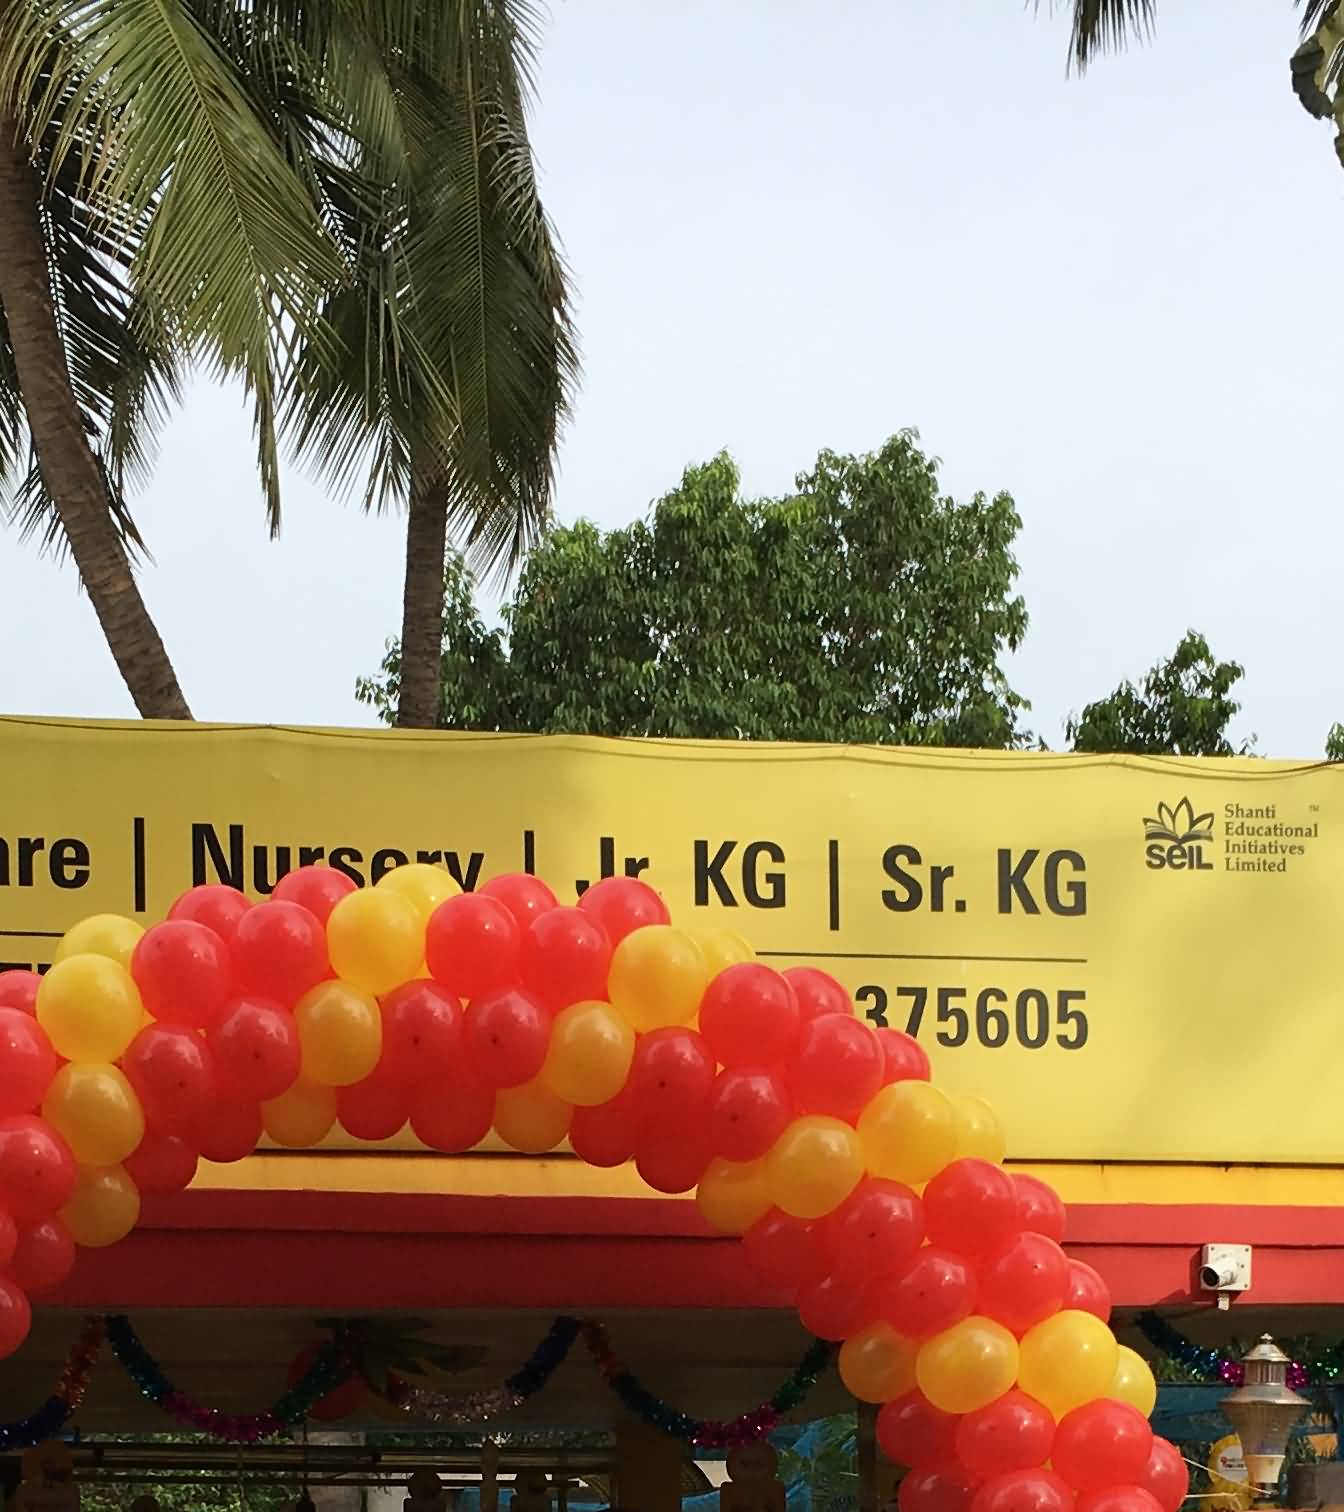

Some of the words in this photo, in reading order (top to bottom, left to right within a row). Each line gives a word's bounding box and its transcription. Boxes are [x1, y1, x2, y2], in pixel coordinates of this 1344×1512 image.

[1224, 803, 1276, 819] Shanti
[1224, 822, 1318, 838] Educational
[1224, 840, 1305, 855] Initiatives
[1224, 857, 1287, 872] Limited
[695, 840, 786, 908] KG
[882, 846, 966, 913] Sr.
[999, 848, 1088, 916] KG
[855, 985, 1088, 1050] 375605
